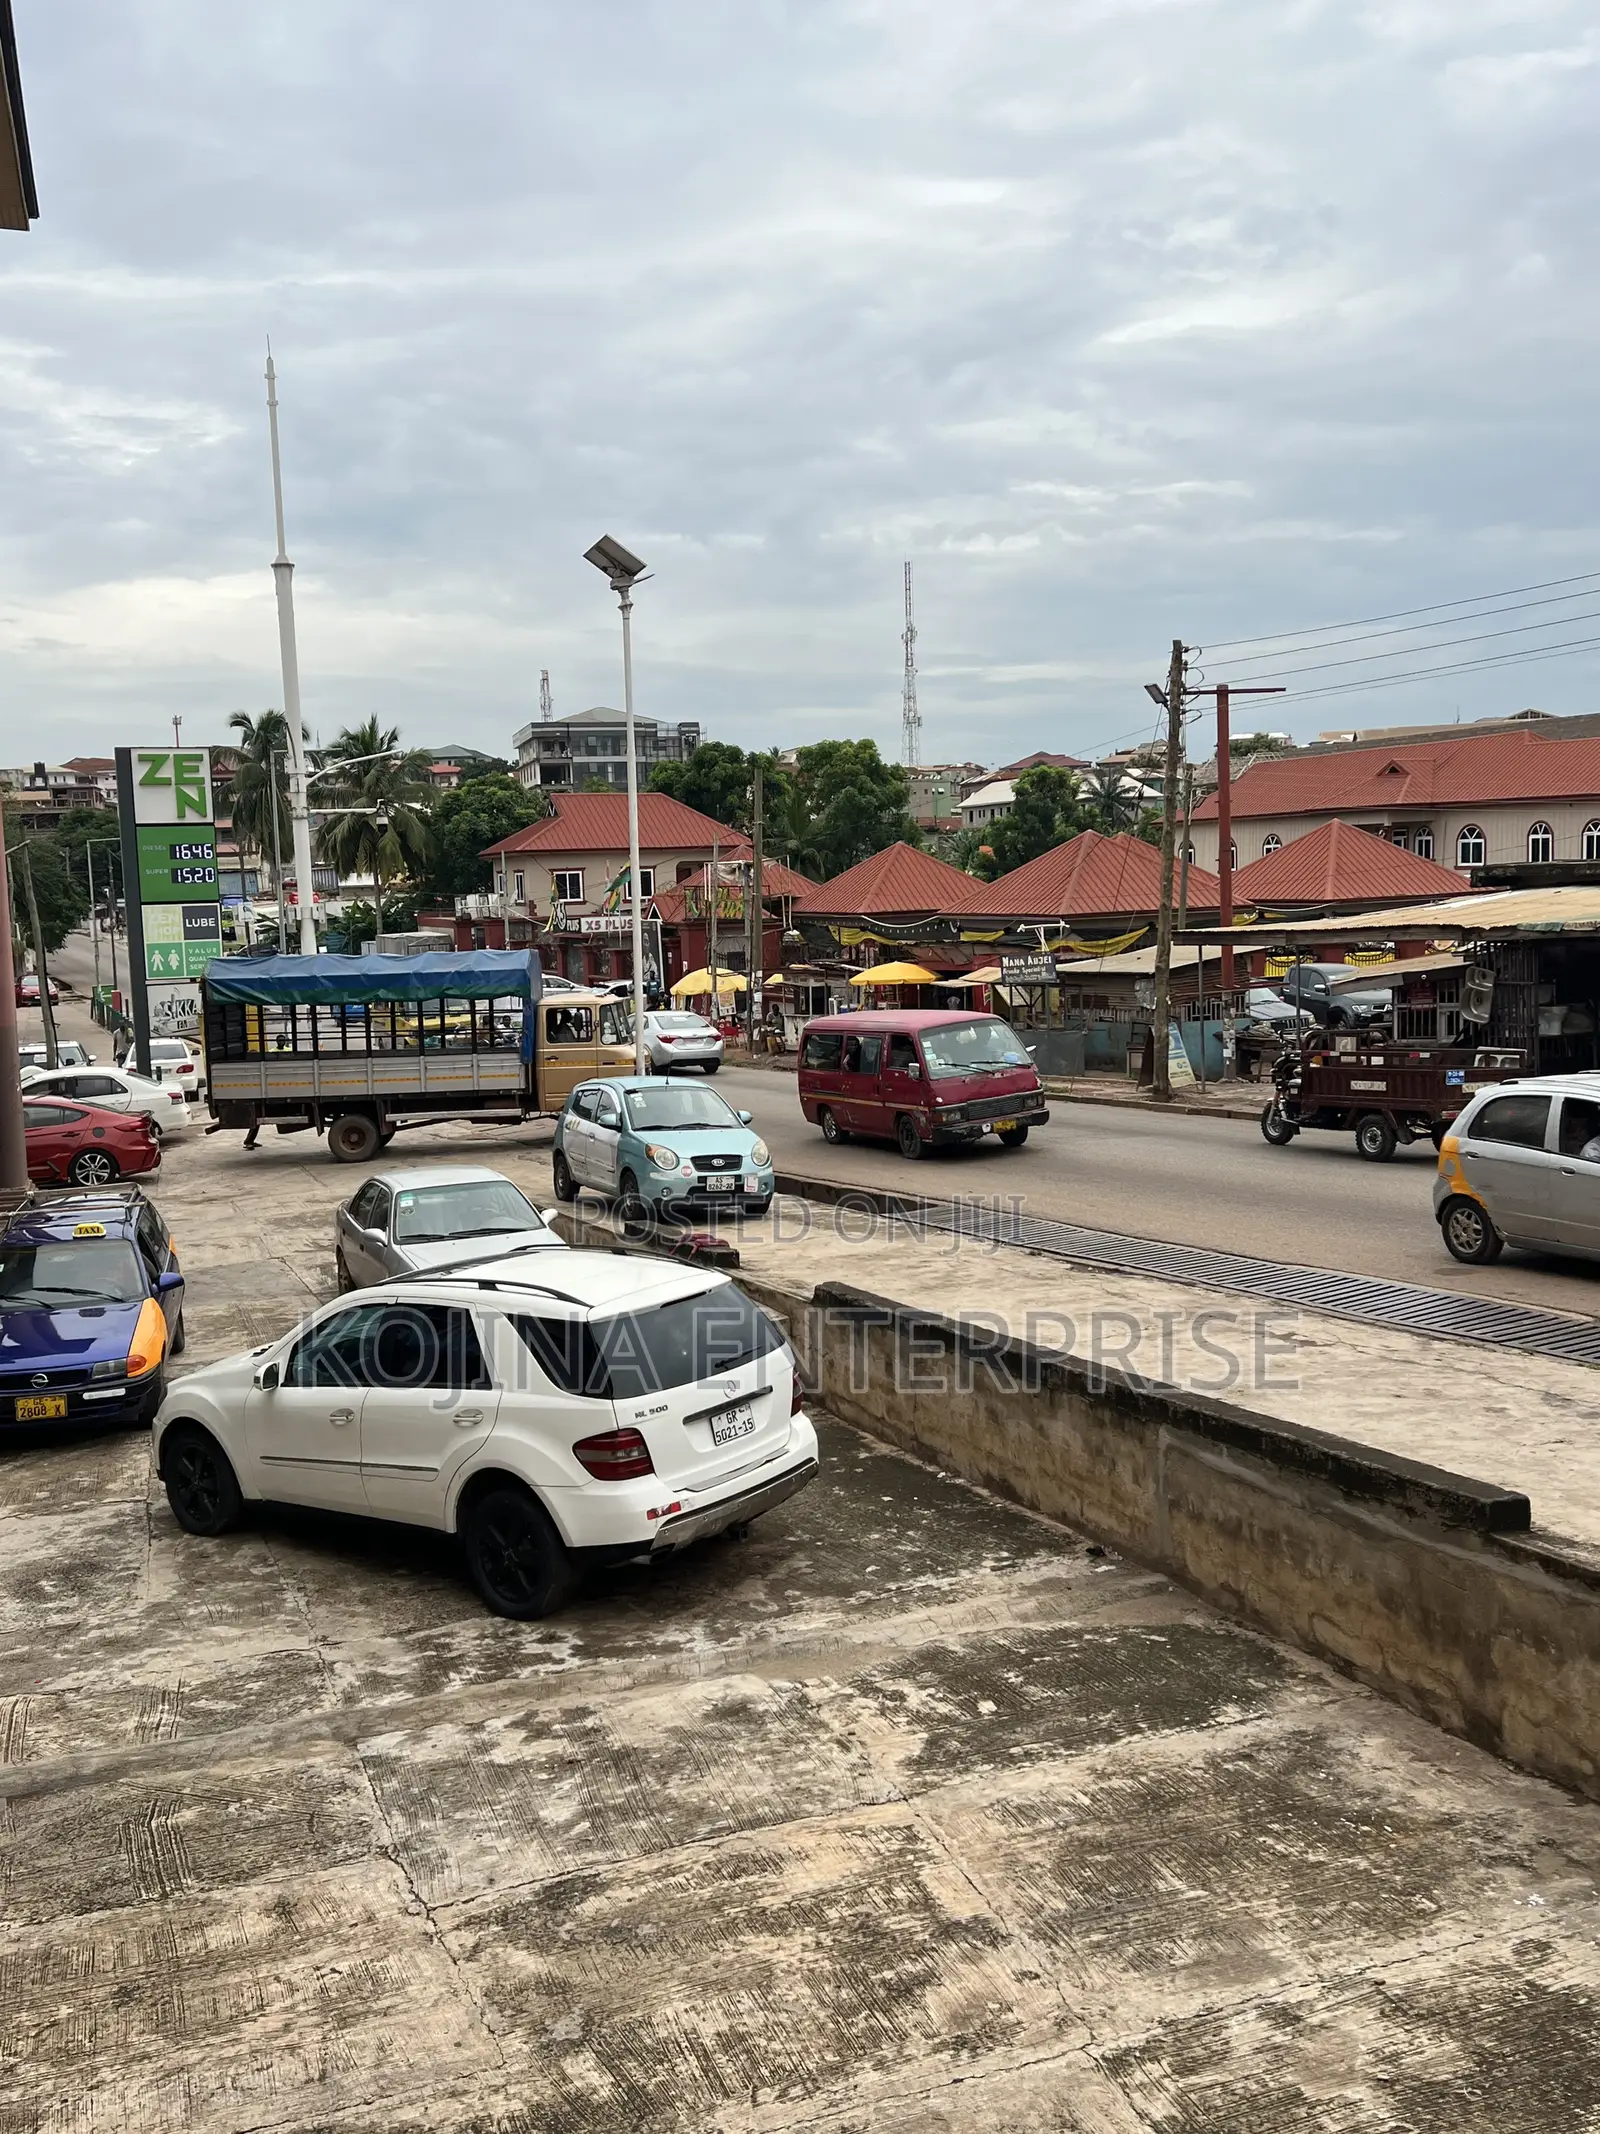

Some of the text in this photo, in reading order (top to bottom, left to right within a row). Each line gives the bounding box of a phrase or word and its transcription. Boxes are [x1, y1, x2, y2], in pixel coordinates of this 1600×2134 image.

[137, 753, 208, 819] ZEN
[175, 843, 213, 859] 16.46
[177, 867, 215, 883] 15.20
[185, 917, 216, 928] LUBE
[585, 920, 601, 931] X5
[605, 919, 634, 931] PLUS
[1002, 956, 1025, 967] NANA
[77, 1226, 100, 1235] TAXI
[20, 1404, 61, 1418] 2808 X
[725, 1409, 739, 1425] GR
